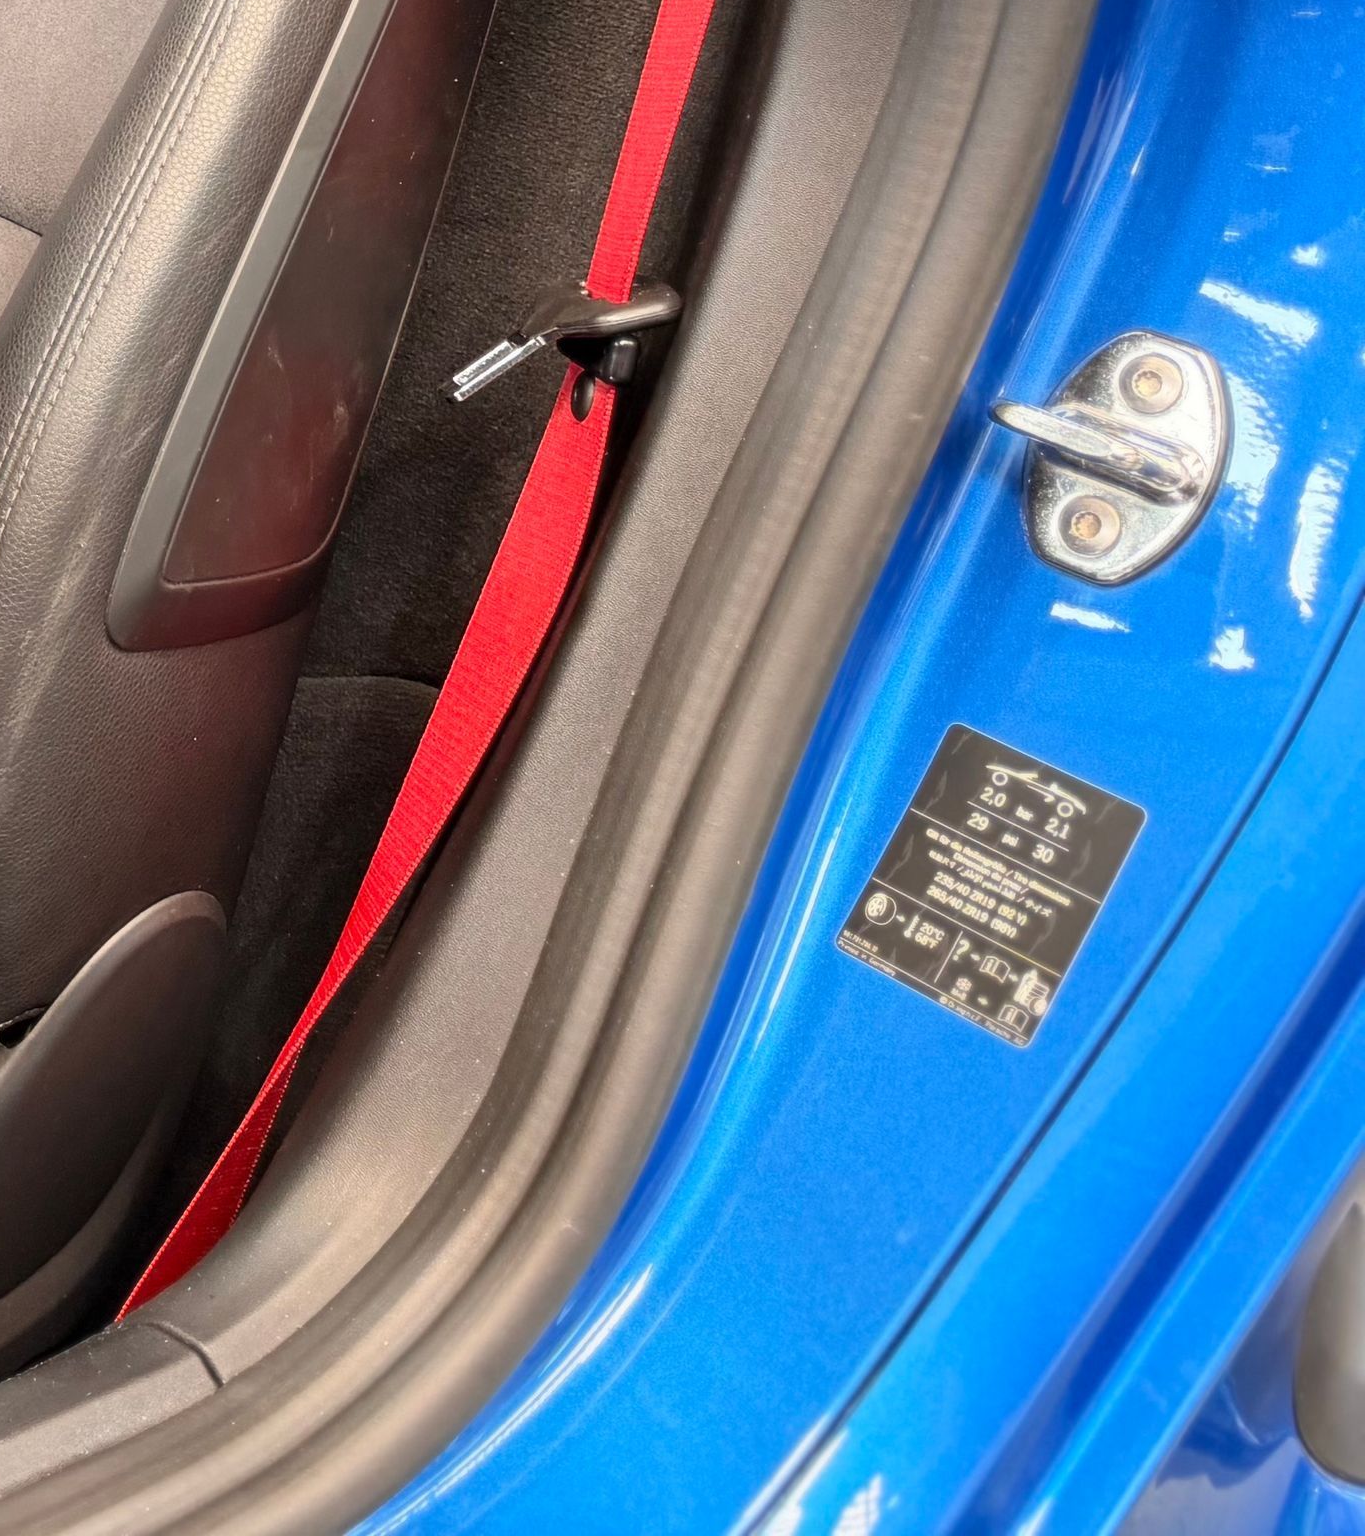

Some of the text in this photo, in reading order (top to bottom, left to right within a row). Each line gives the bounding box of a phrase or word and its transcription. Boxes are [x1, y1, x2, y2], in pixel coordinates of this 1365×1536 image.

[980, 786, 1070, 840] 2,0 bar 2,1
[967, 812, 1055, 864] 29 psi 30
[926, 885, 964, 910] 265/40
[962, 902, 989, 923] ZR19
[933, 871, 971, 897] 235/40
[969, 889, 997, 909] ZR19
[919, 922, 946, 941] 20°C
